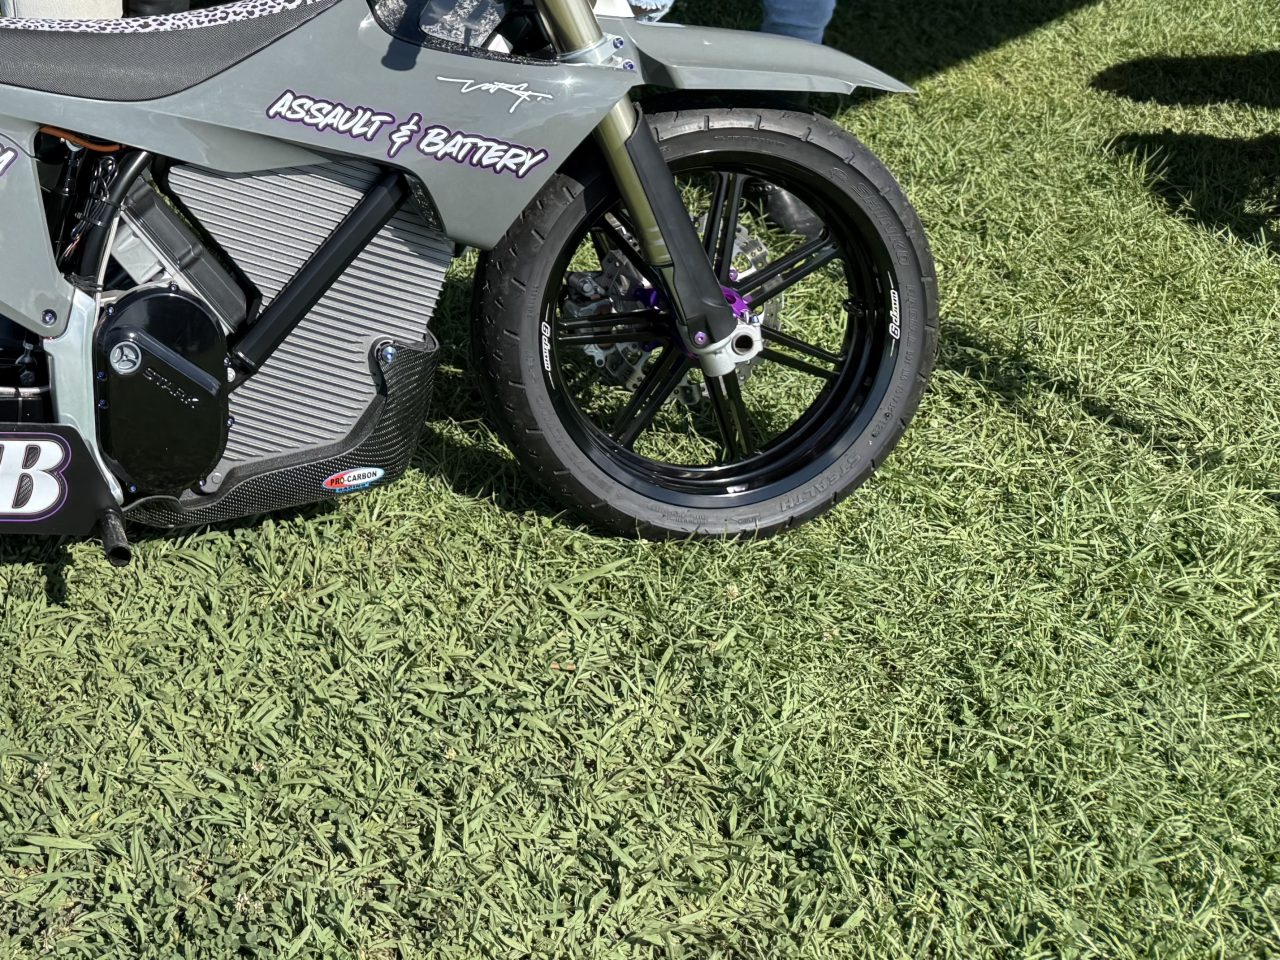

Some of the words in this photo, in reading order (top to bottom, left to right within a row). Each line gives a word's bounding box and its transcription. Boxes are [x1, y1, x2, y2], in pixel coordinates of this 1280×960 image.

[267, 90, 395, 141] ASSAULT
[388, 113, 422, 158] &
[418, 125, 548, 178] BATTERY
[849, 182, 911, 266] SHINKO
[141, 367, 200, 409] STARK
[778, 451, 862, 512] STEALTH
